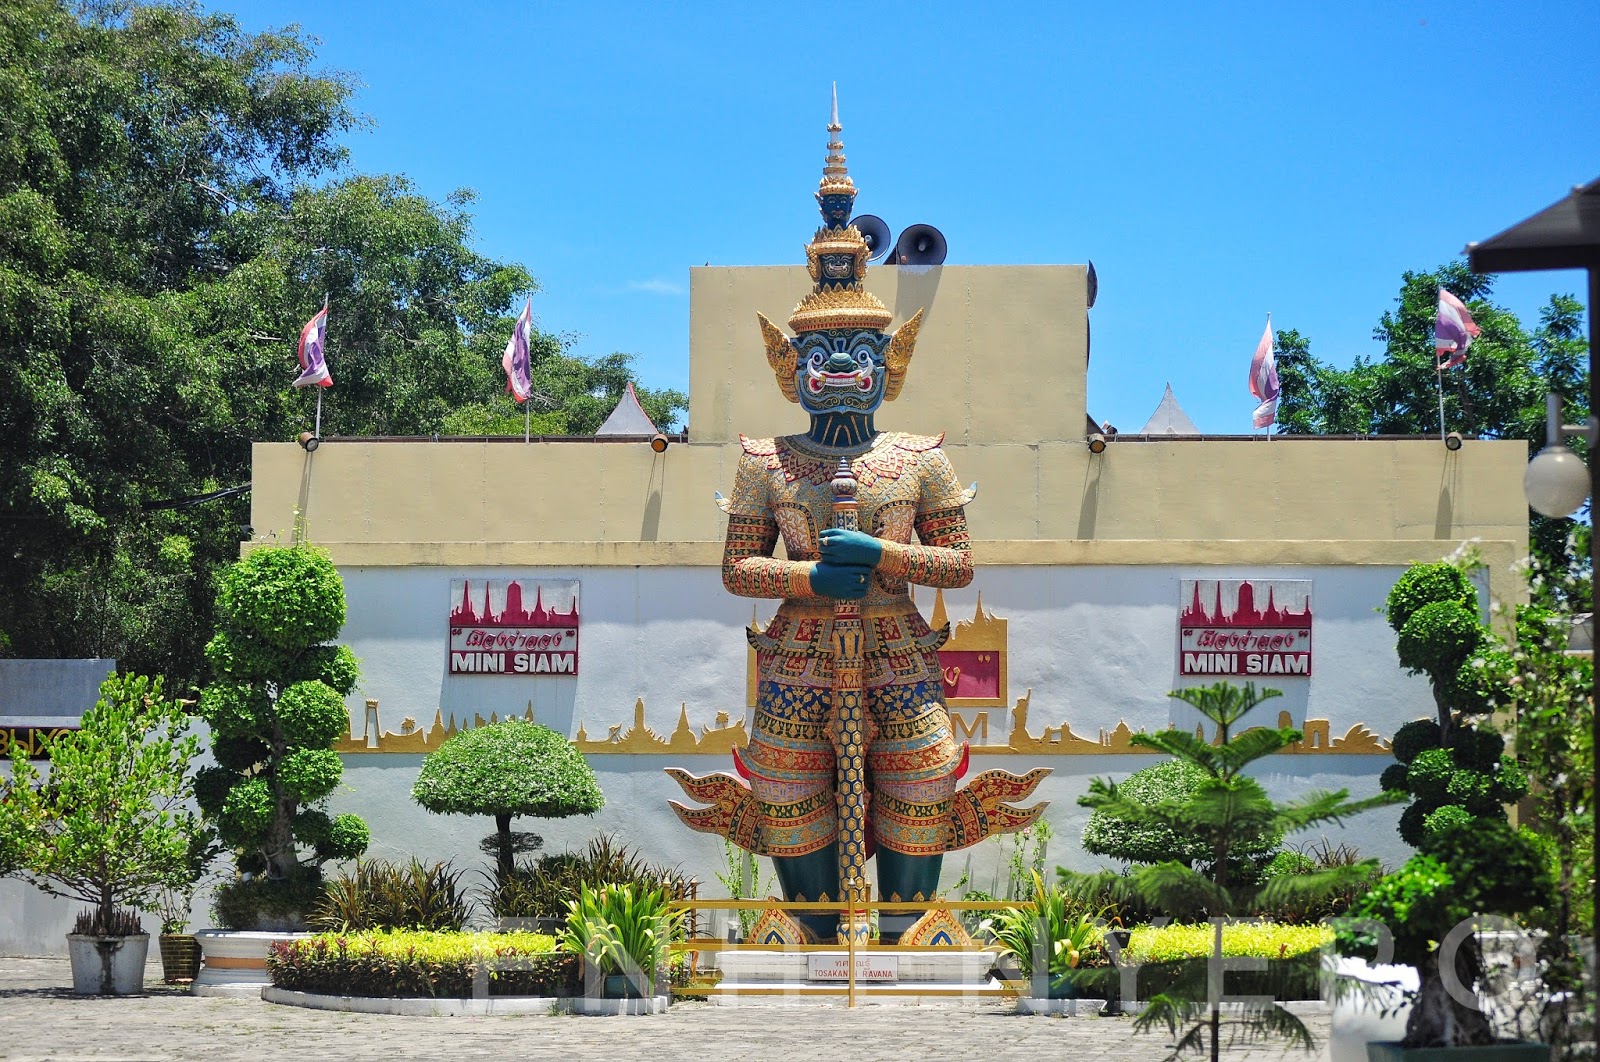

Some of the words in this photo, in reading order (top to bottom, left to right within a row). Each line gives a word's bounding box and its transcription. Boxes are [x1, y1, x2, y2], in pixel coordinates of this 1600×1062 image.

[452, 653, 505, 672] MINI
[514, 653, 574, 673] SIAM
[1184, 653, 1238, 673] MINI
[1247, 654, 1308, 674] SIAM
[814, 969, 858, 978] TOSAKANH
[862, 969, 893, 978] RAVANA
